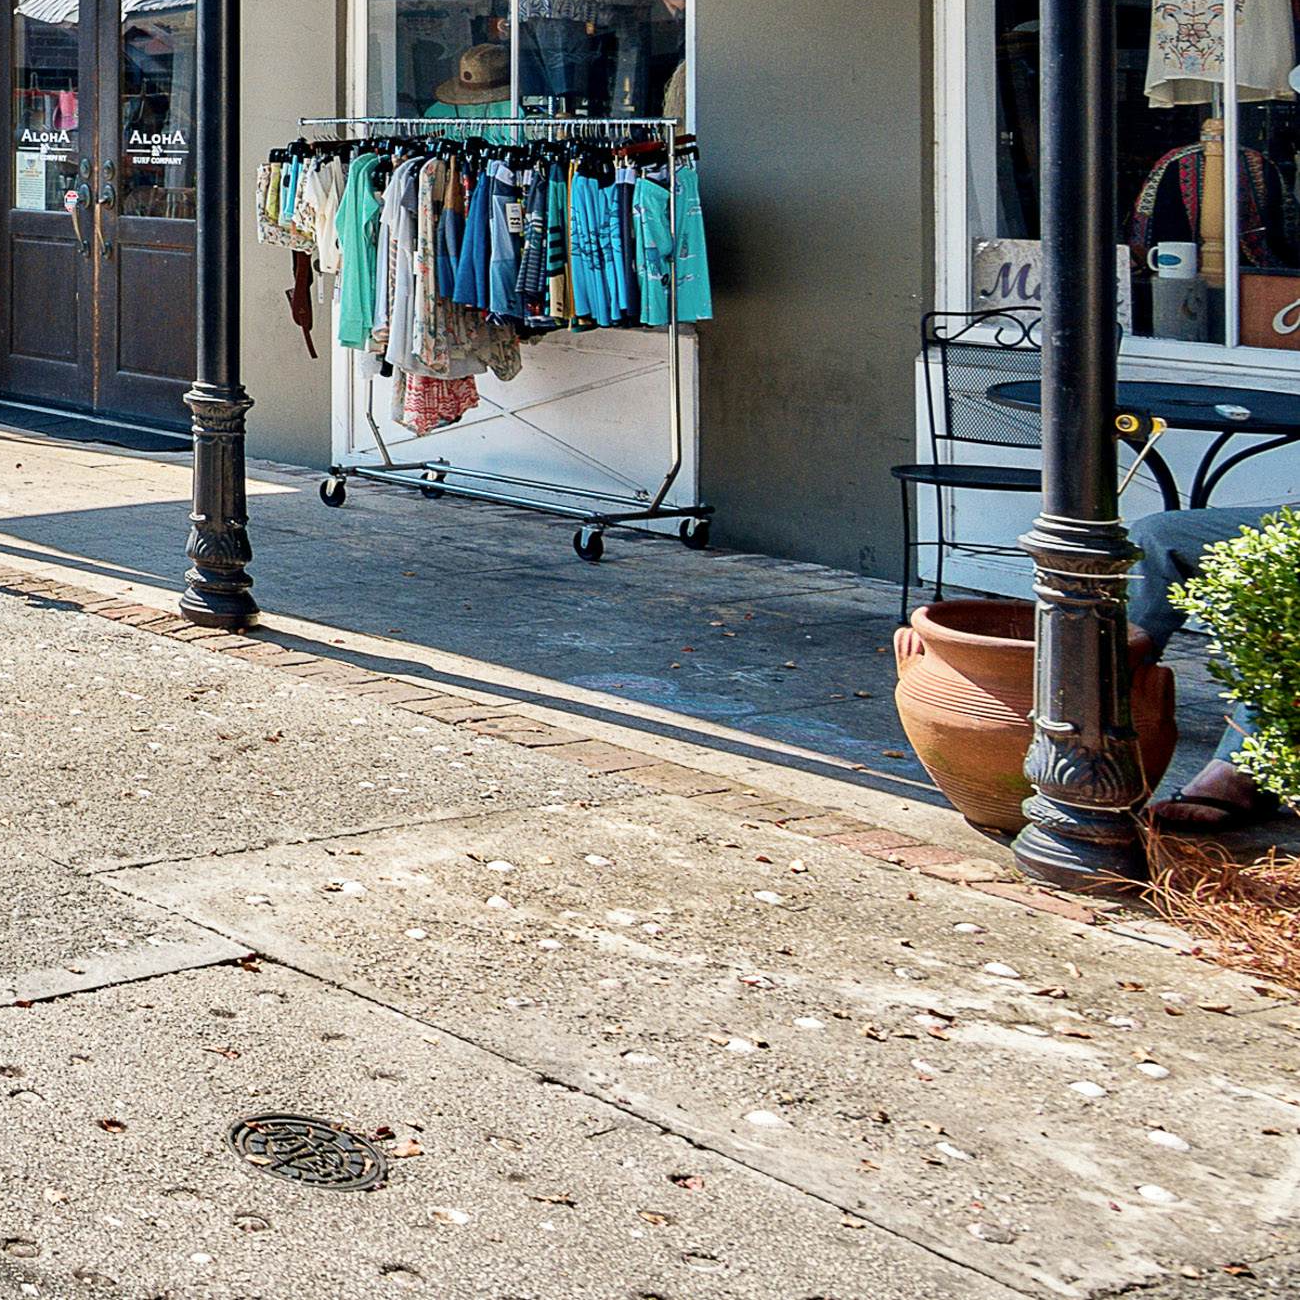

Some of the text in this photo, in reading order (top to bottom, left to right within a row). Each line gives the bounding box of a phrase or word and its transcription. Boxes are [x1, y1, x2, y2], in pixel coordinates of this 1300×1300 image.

[21, 129, 70, 143] ALOHA
[129, 130, 186, 145] ALOHA
[132, 156, 183, 165] SURF COMPANY
